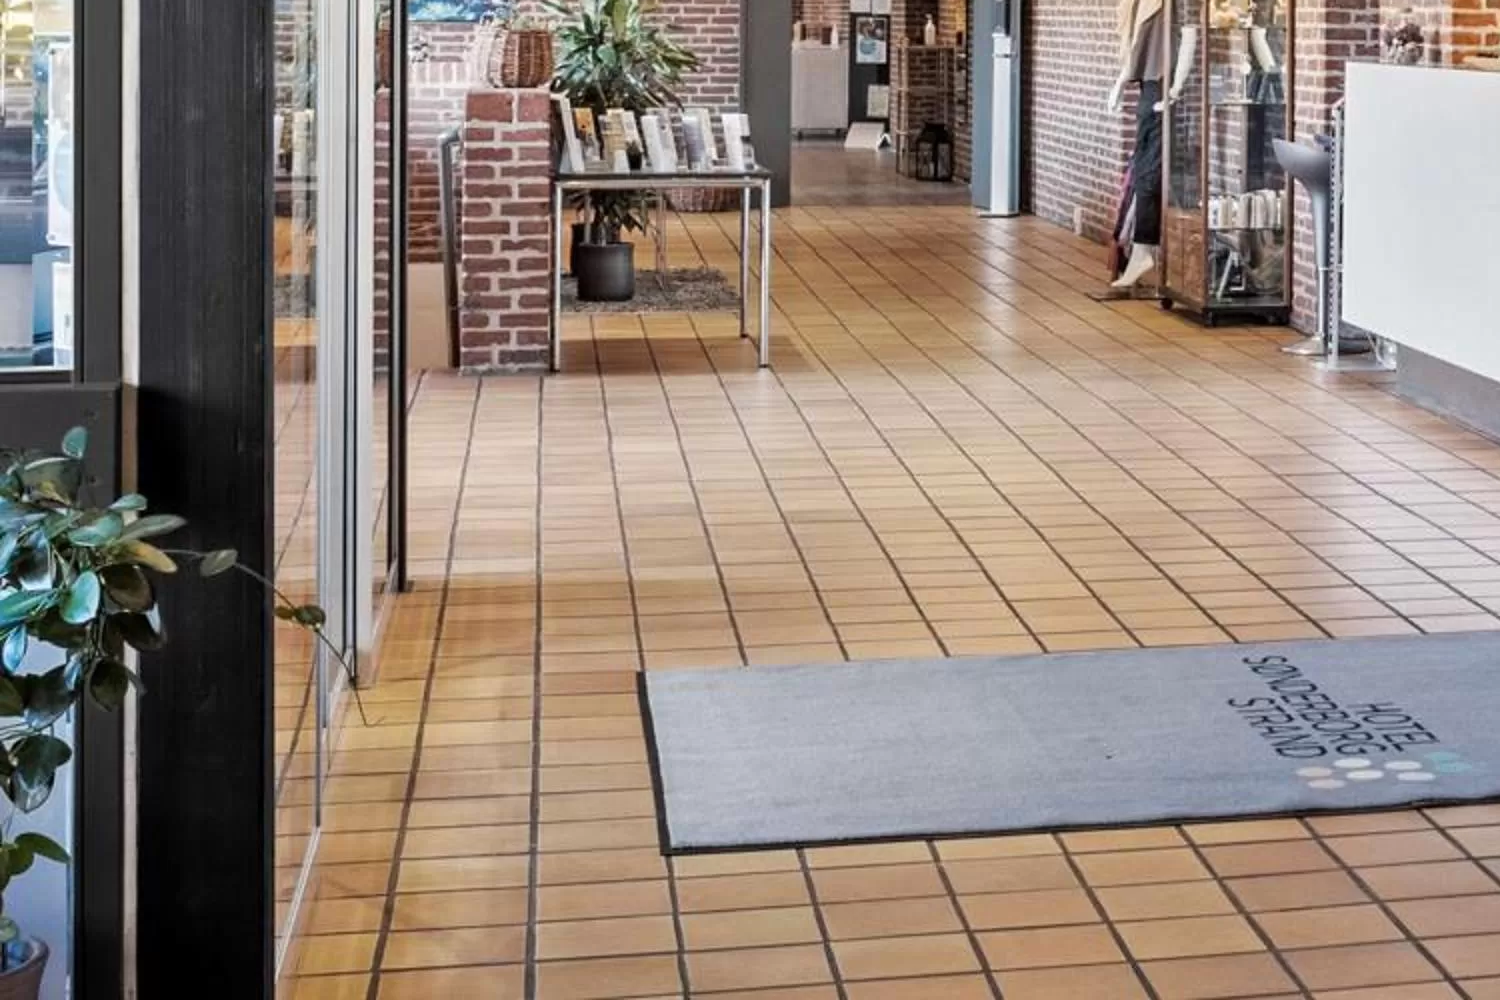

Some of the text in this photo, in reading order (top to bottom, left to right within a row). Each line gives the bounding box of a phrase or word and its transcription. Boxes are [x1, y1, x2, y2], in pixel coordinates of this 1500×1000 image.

[1228, 697, 1327, 758] STRAND
[1242, 655, 1388, 756] SØNDERBORG
[1347, 701, 1440, 752] HOTEL
